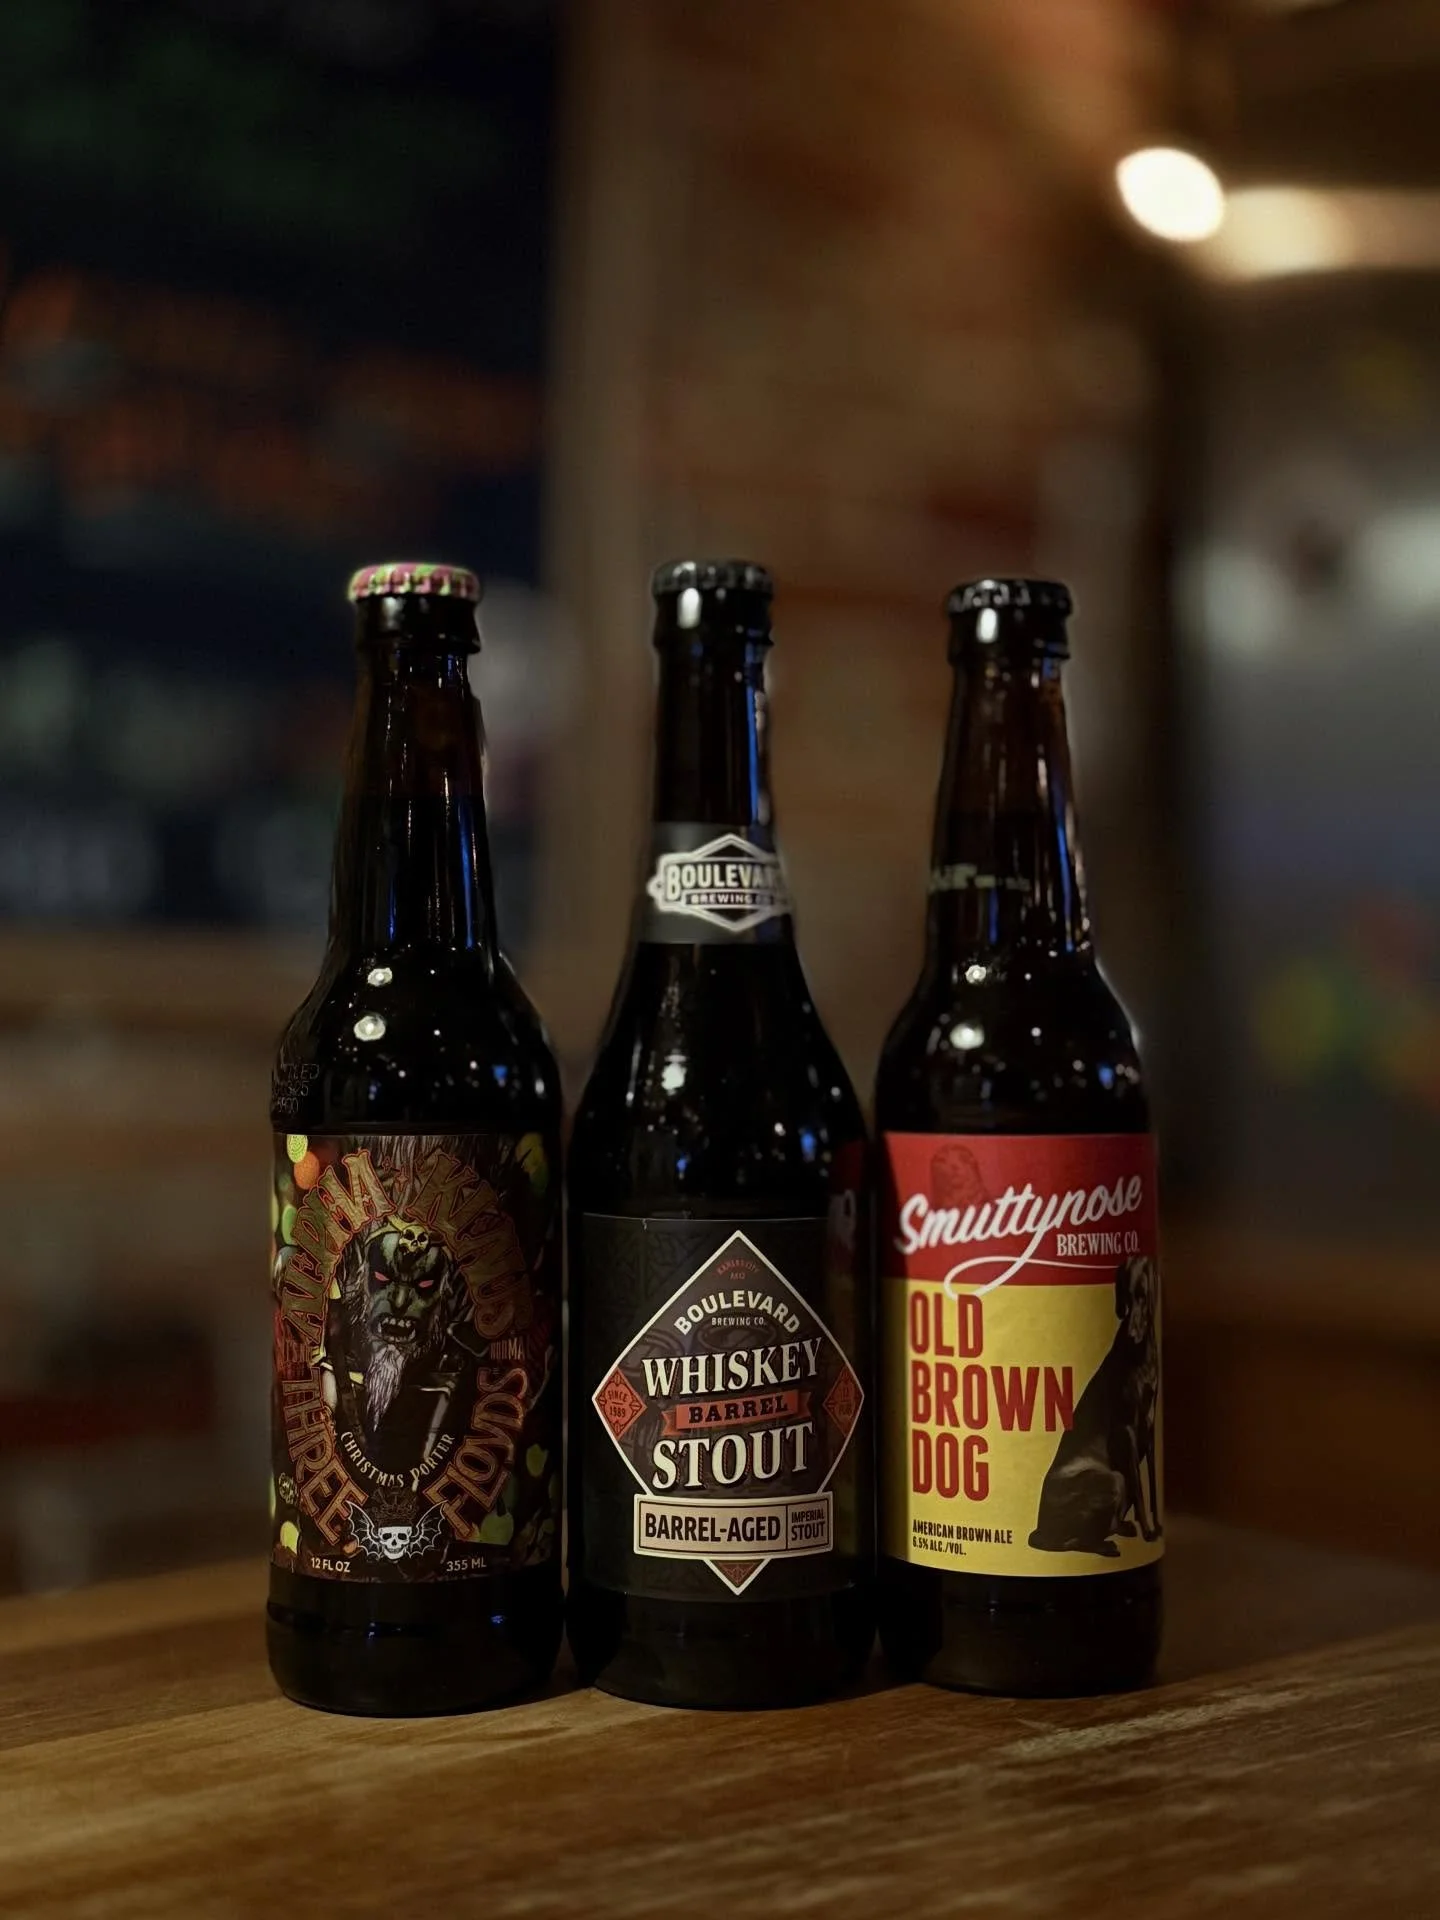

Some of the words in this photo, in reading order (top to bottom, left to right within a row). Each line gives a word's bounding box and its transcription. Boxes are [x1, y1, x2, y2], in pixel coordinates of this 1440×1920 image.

[893, 1174, 1143, 1299] Smuttynose
[1056, 1231, 1123, 1257] BREWING
[1124, 1231, 1140, 1254] CO.
[673, 1289, 800, 1335] BOULEVARD
[711, 1316, 751, 1326] BREWING
[909, 1291, 983, 1359] OLD
[641, 1337, 825, 1398] WHISKEY
[610, 1406, 626, 1418] 1989
[687, 1391, 789, 1424] BARREL
[910, 1359, 1073, 1432] BROWN
[282, 1366, 369, 1546] THREE
[340, 1431, 404, 1488] CHRISTMAS
[410, 1433, 455, 1492] PORTER
[422, 1367, 528, 1540] FLOYDS
[651, 1420, 814, 1491] STOUT
[912, 1429, 989, 1502] DOG
[645, 1512, 781, 1543] BARREL-AGED
[791, 1510, 825, 1523] IMPERIAL
[791, 1522, 825, 1541] STOUT
[912, 1519, 954, 1538] AMERICAN
[956, 1525, 991, 1542] BROWN
[993, 1529, 1012, 1543] ALE
[912, 1537, 928, 1549] 6.5%
[929, 1538, 966, 1555] ALC./VOL.
[310, 1557, 321, 1569] 12
[322, 1558, 334, 1571] FL
[335, 1560, 350, 1573] OZ
[446, 1558, 468, 1572] 355
[470, 1556, 487, 1570] ML
